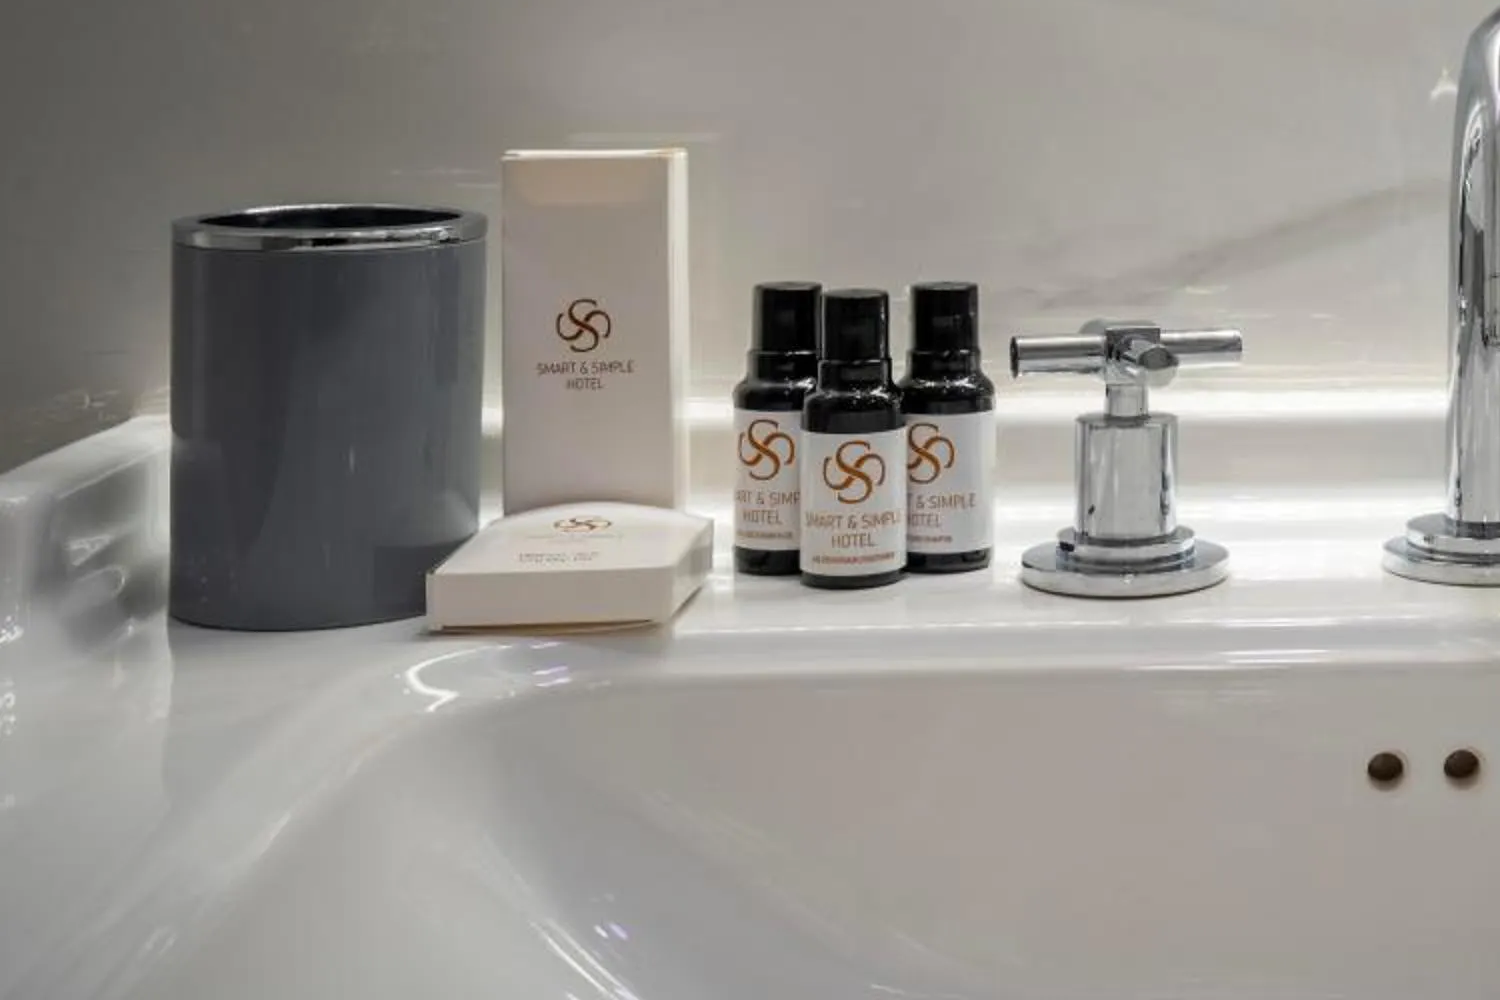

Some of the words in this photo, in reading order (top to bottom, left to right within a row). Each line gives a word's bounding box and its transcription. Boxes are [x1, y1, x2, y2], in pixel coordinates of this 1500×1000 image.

[536, 361, 577, 375] SMART
[579, 360, 589, 375] &
[591, 359, 635, 374] SIMPLE
[566, 378, 604, 390] HOTEL
[756, 490, 765, 505] &
[915, 493, 925, 509] &
[927, 492, 976, 510] SIMPLE
[742, 509, 783, 525] HOTEL
[847, 514, 858, 529] &
[831, 532, 878, 549] HOTEL
